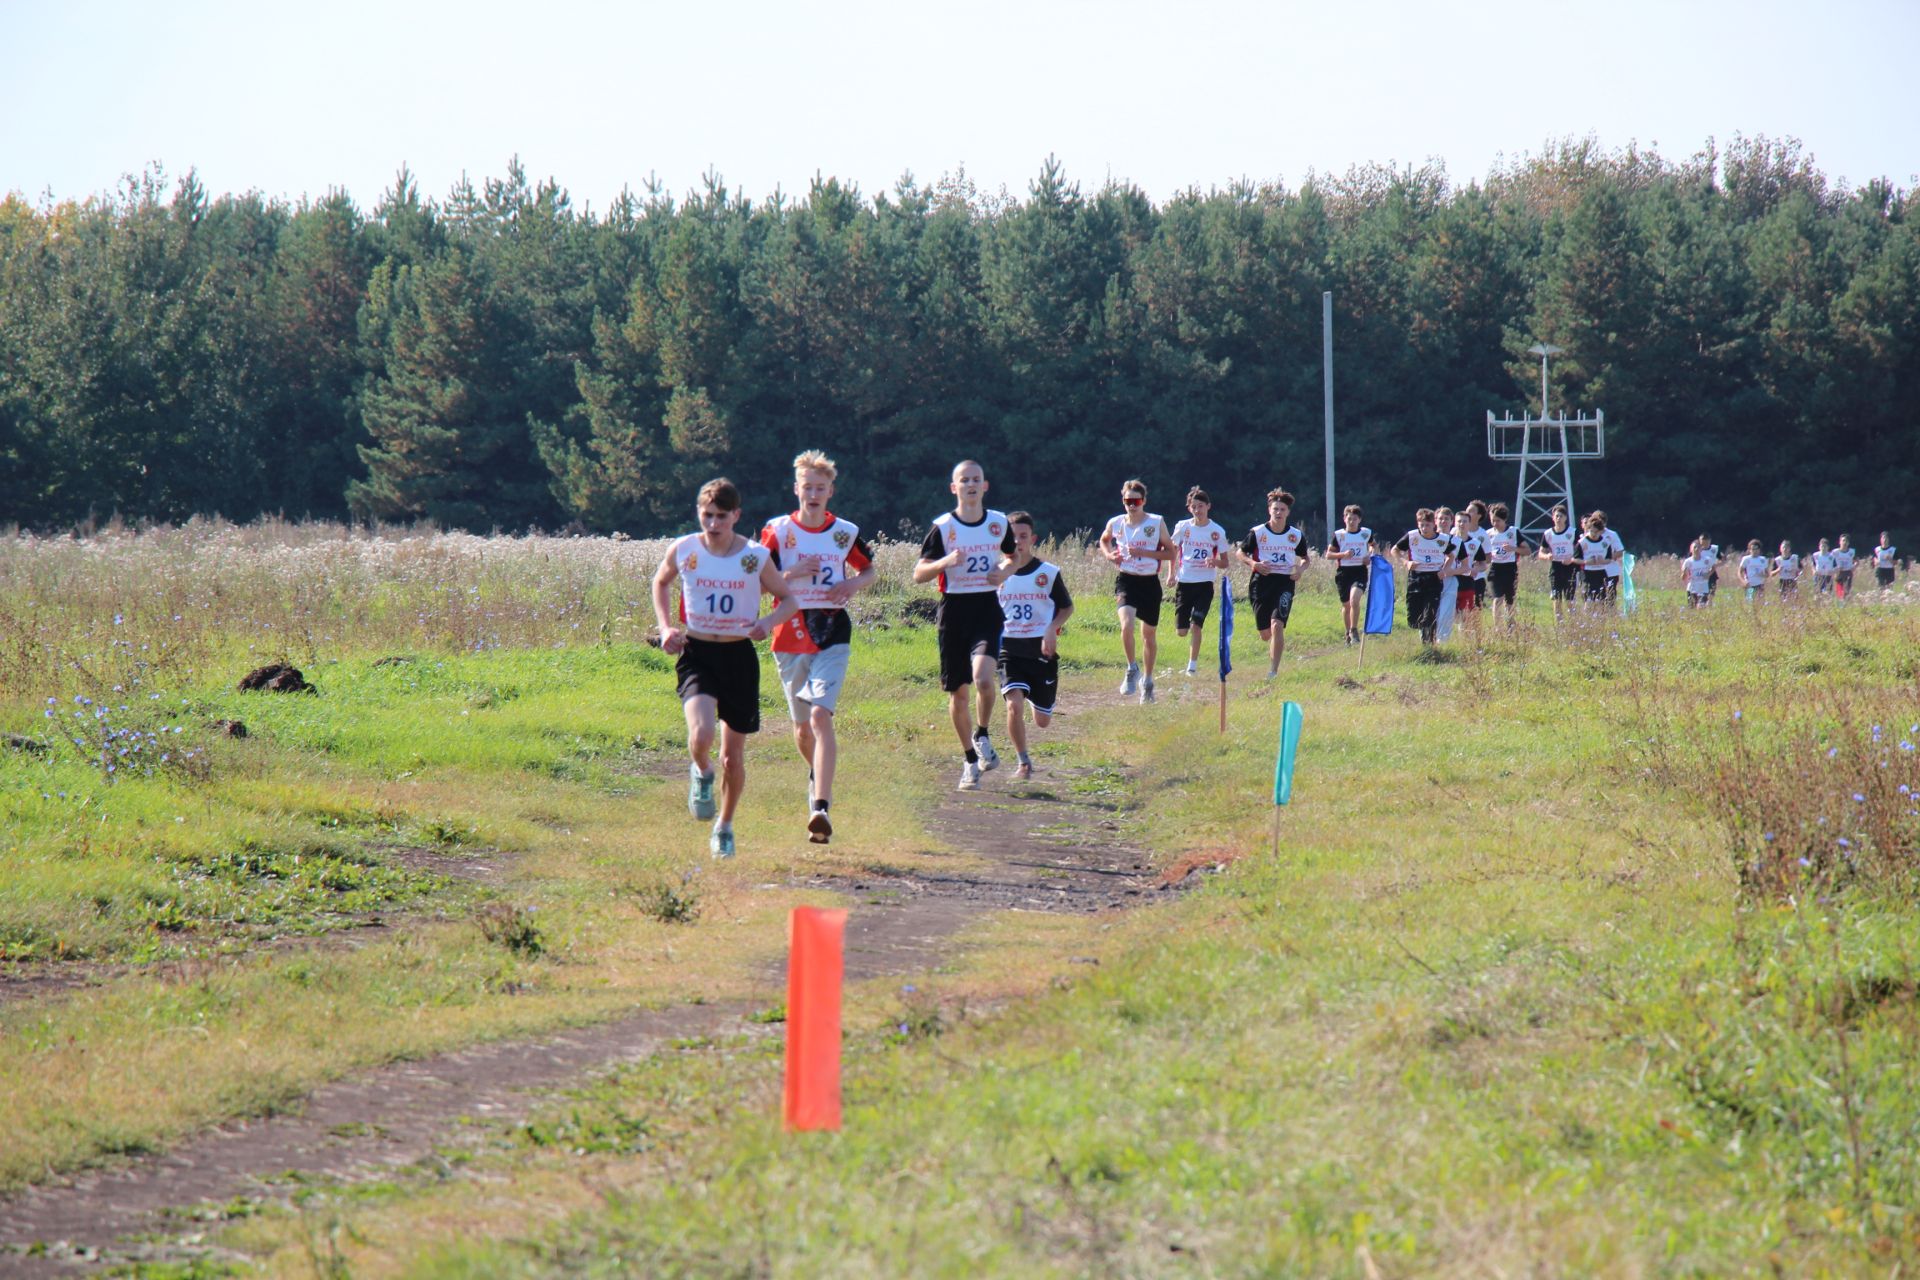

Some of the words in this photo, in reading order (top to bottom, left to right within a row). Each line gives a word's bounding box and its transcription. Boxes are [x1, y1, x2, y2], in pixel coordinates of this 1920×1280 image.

[1193, 548, 1208, 559] 26
[1271, 552, 1286, 563] 34
[1425, 555, 1431, 563] 8
[966, 555, 990, 573] 23
[811, 566, 834, 586] 12
[696, 577, 745, 590] РОССИЯ
[705, 593, 734, 614] 10
[1012, 604, 1033, 620] 38
